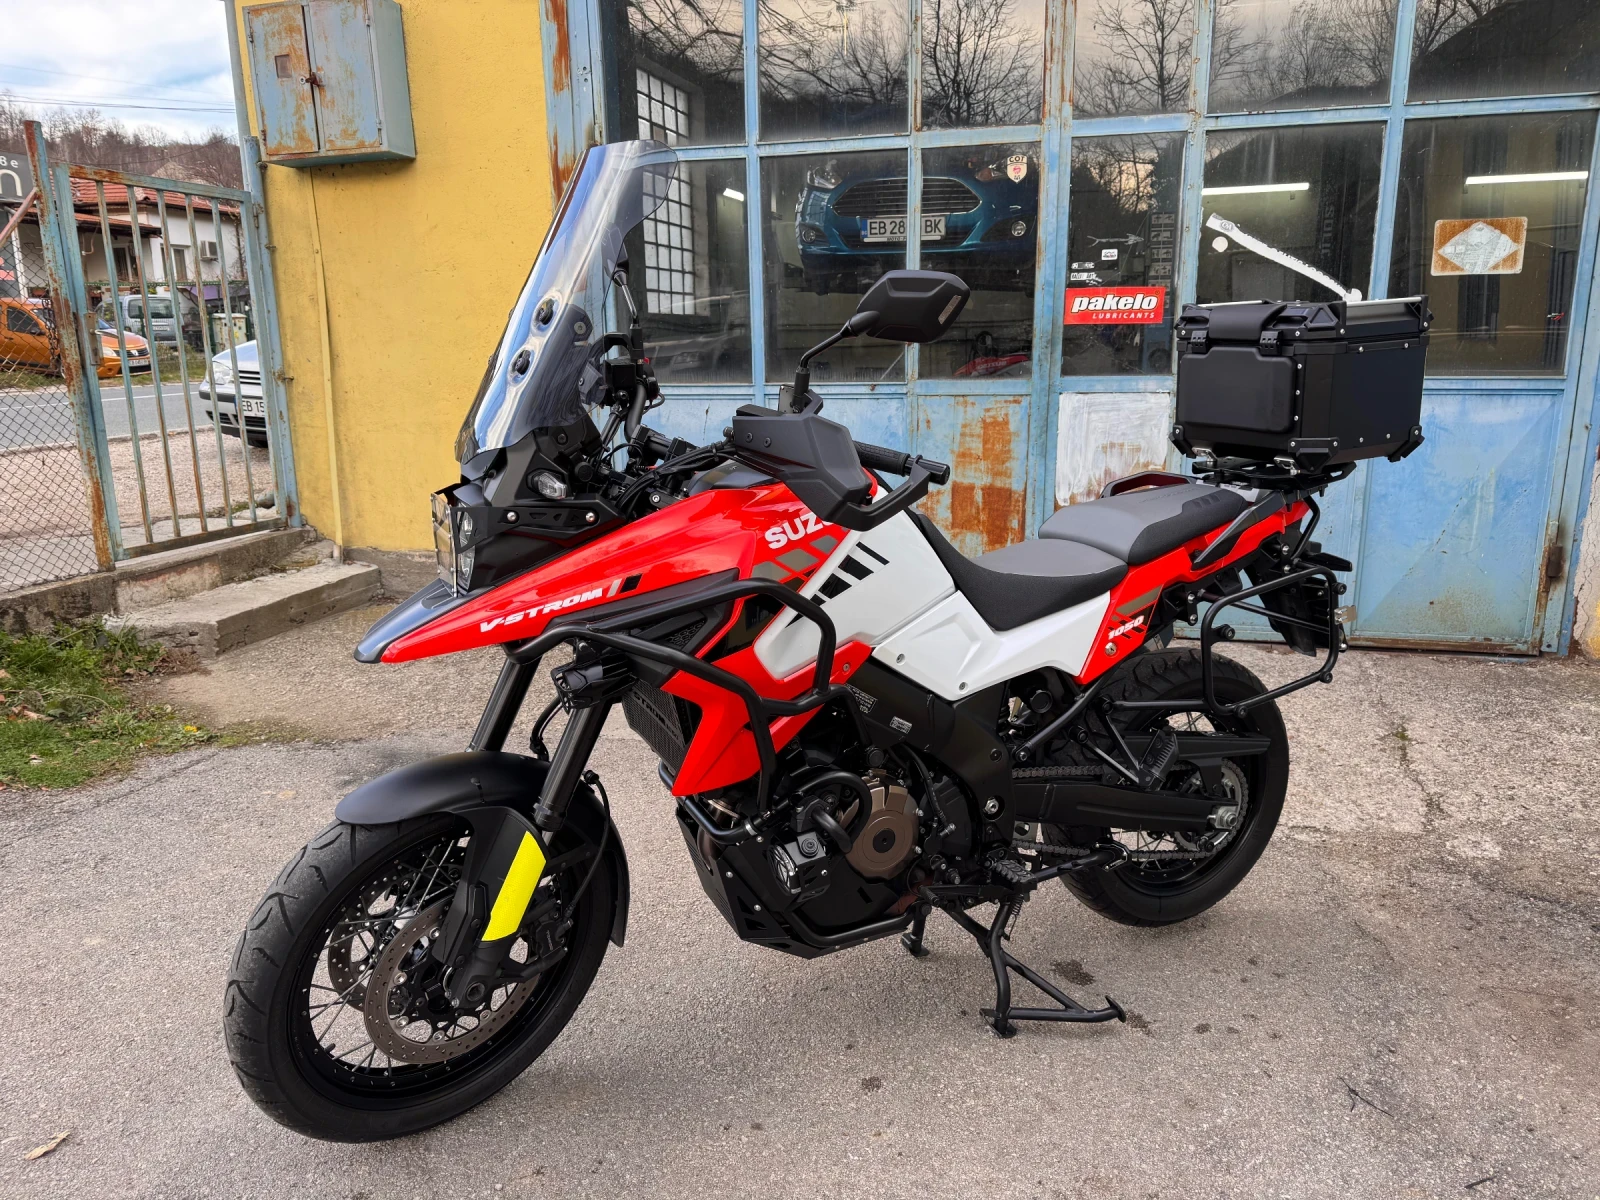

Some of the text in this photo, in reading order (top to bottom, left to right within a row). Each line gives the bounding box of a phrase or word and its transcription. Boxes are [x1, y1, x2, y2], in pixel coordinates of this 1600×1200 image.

[869, 219, 942, 236] EB 28 BK
[1071, 293, 1158, 313] pakelo
[765, 512, 833, 549] SUZ
[480, 588, 603, 632] V-STROM
[1108, 615, 1144, 640] 1050
